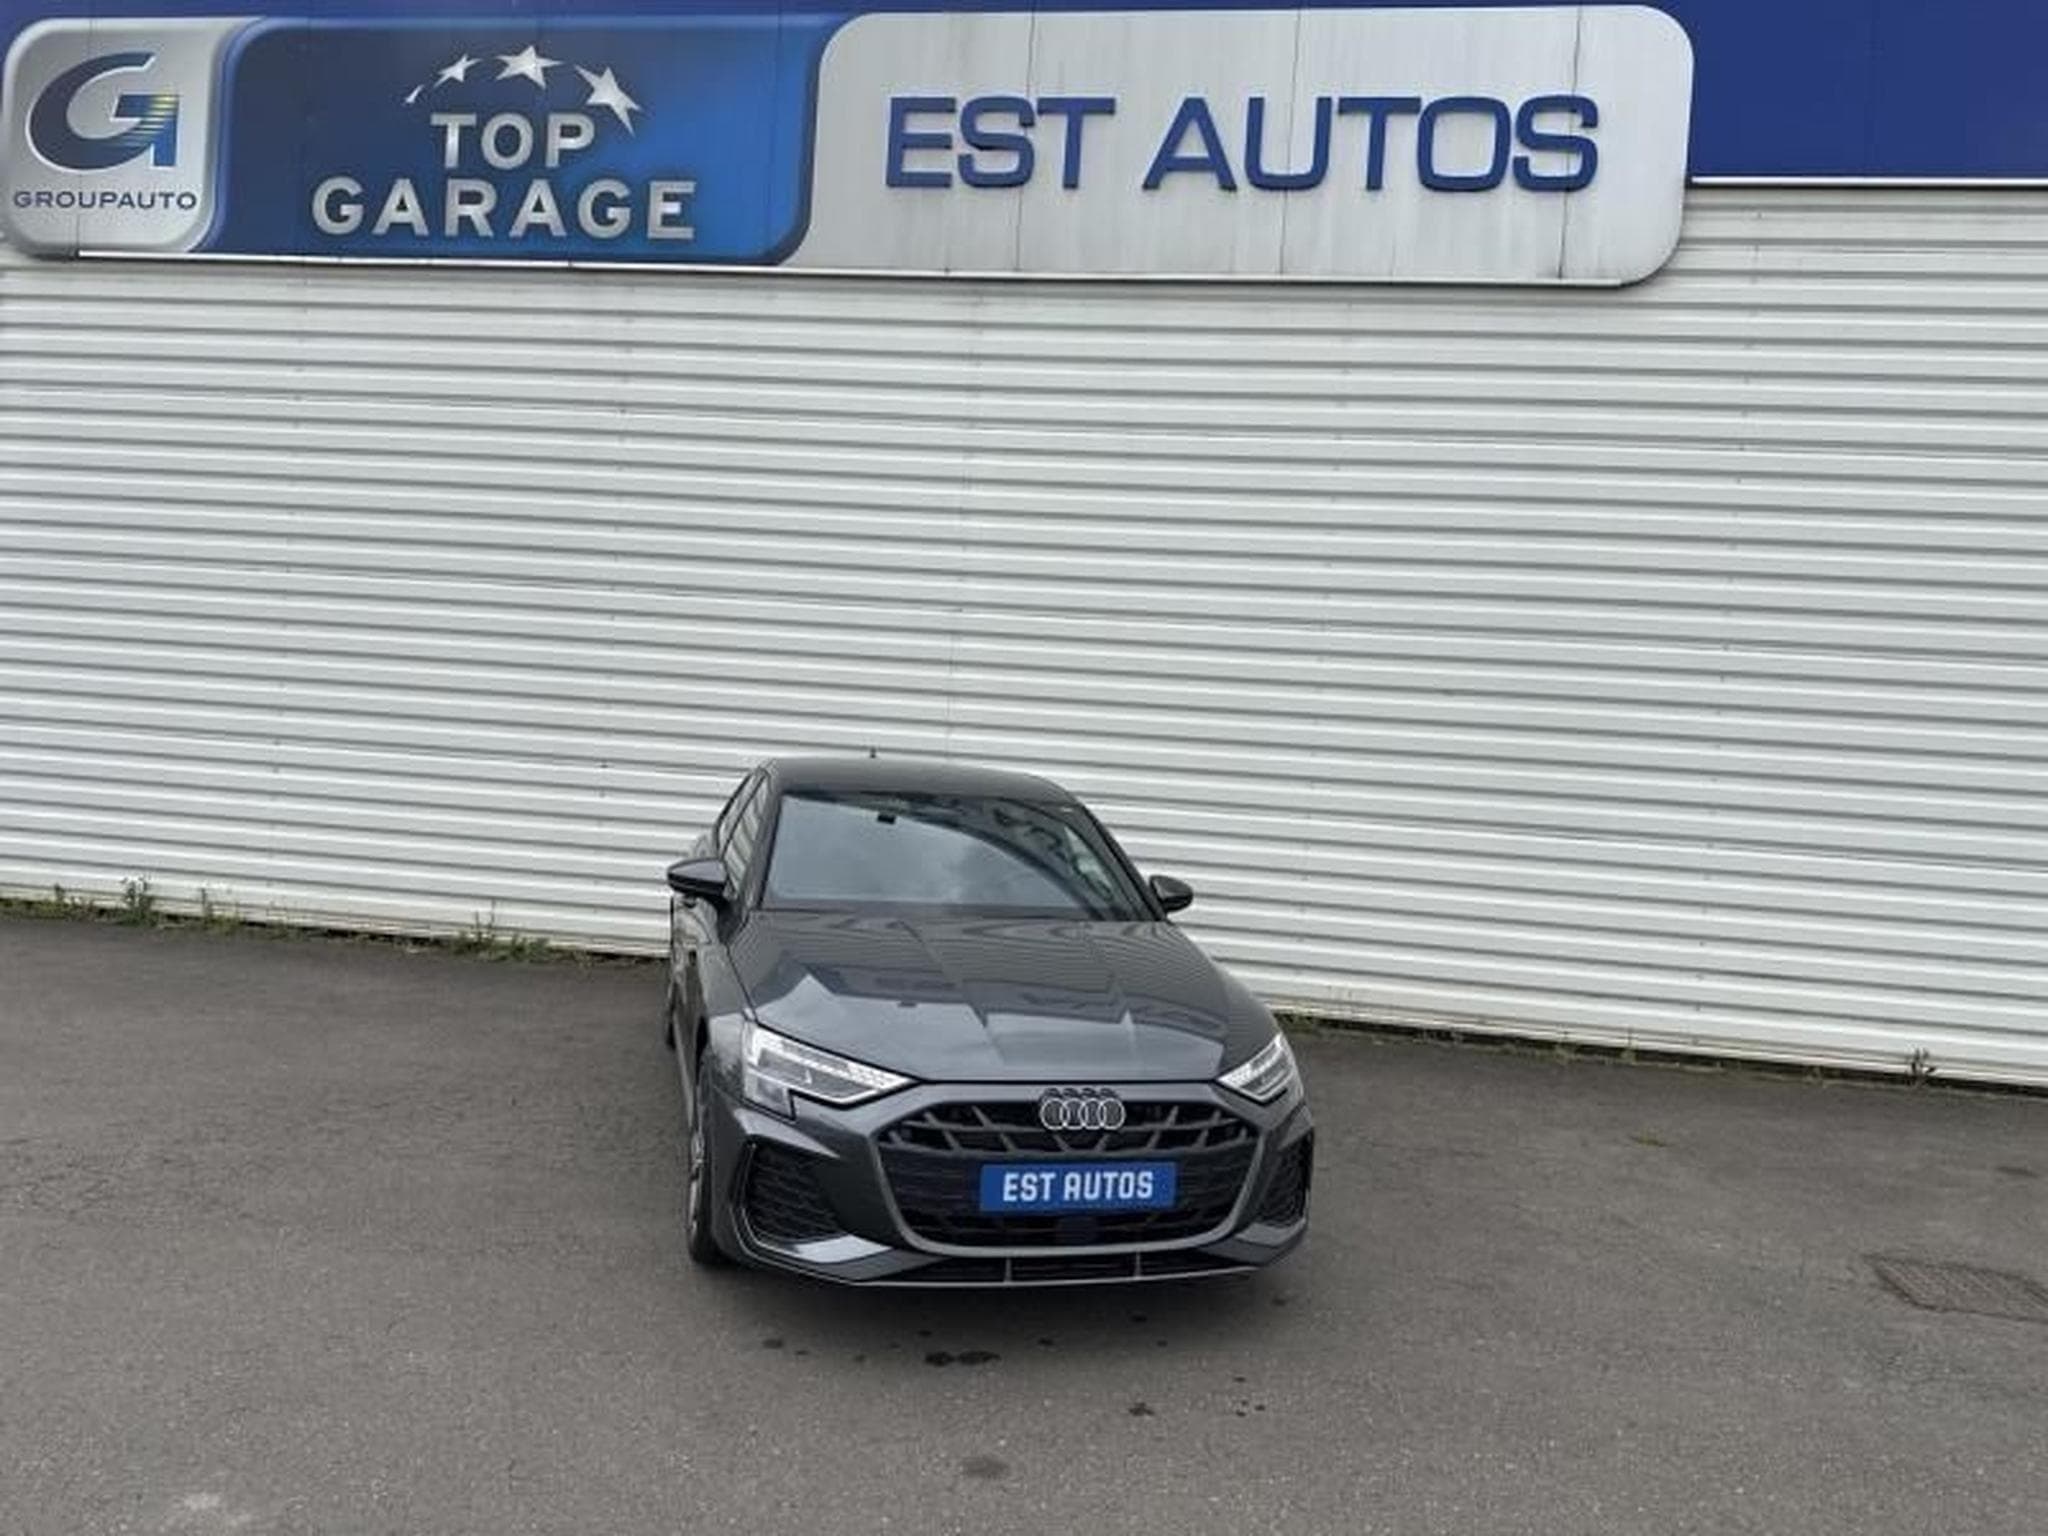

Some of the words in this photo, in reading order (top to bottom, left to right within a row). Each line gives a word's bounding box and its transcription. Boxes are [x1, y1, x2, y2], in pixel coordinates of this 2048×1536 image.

[430, 112, 597, 169] TOP
[886, 95, 1115, 190] EST
[1143, 94, 1599, 192] AUTOS
[13, 190, 198, 210] GROUPAUTO
[311, 177, 697, 240] GARAGE
[1003, 1173, 1056, 1202] EST
[1063, 1171, 1154, 1201] AUTOS
